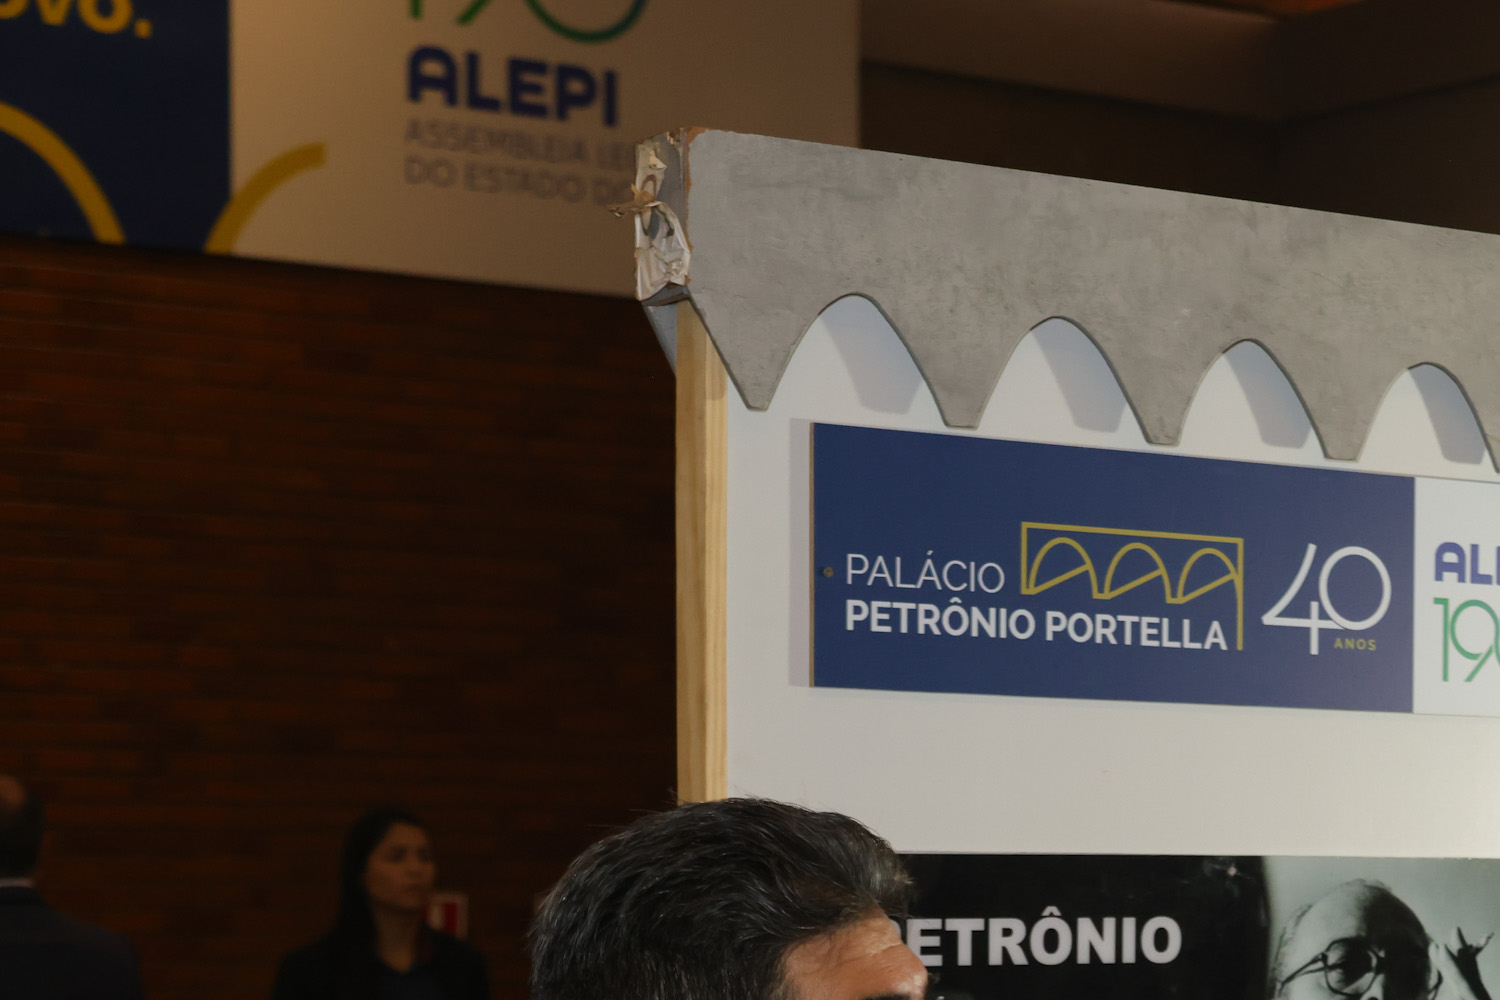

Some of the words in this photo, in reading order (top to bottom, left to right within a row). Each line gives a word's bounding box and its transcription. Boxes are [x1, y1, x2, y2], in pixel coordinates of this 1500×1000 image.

[408, 46, 619, 126] ALEPI
[405, 155, 458, 187] DO
[465, 159, 585, 201] ESTADO
[846, 550, 1005, 593] PALÁCIO
[846, 597, 1036, 640] PETRÔNIO
[1045, 611, 1228, 651] PORTELLA
[1262, 543, 1392, 655] 40
[1334, 638, 1376, 651] ANOS
[893, 906, 1183, 967] ETRÔNIO
